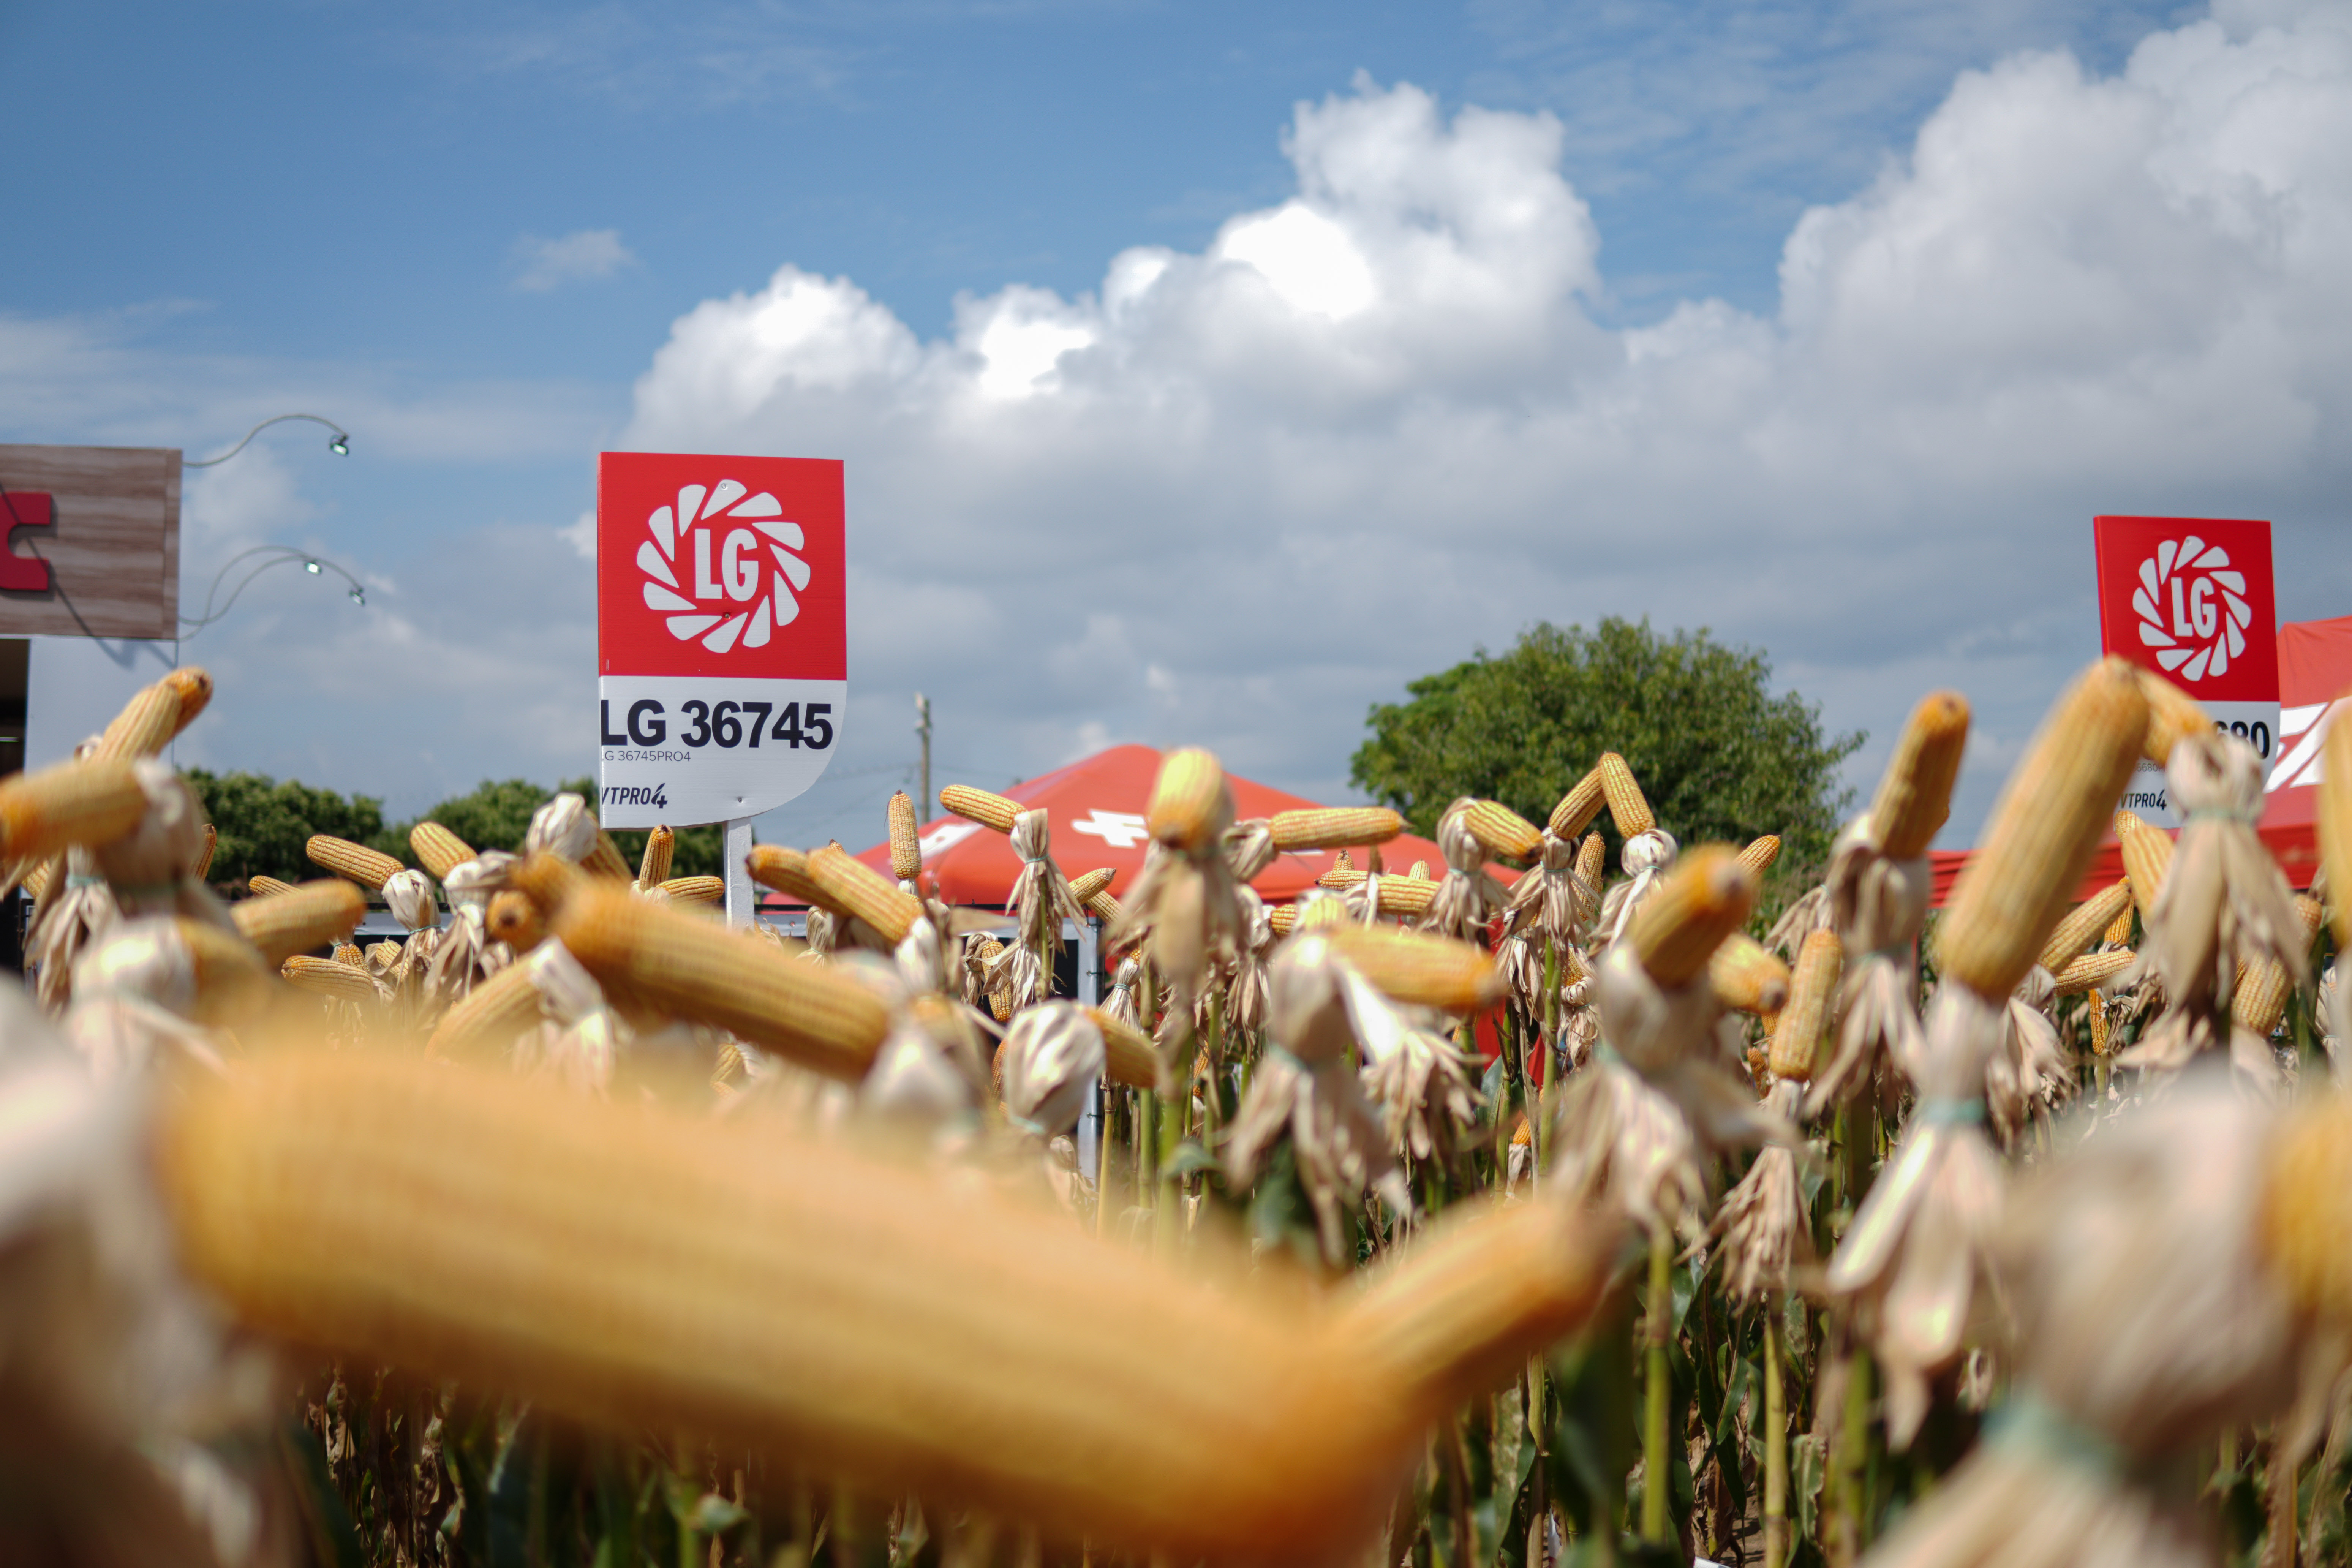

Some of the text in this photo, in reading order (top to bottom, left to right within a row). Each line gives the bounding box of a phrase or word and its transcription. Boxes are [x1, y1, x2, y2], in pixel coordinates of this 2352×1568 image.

[694, 528, 759, 602] LG
[2170, 576, 2216, 639] LG
[601, 699, 833, 750] LG 36745
[2212, 720, 2270, 760] 680
[618, 751, 691, 762] 36745PRO4
[2120, 789, 2167, 811] VTPRO4
